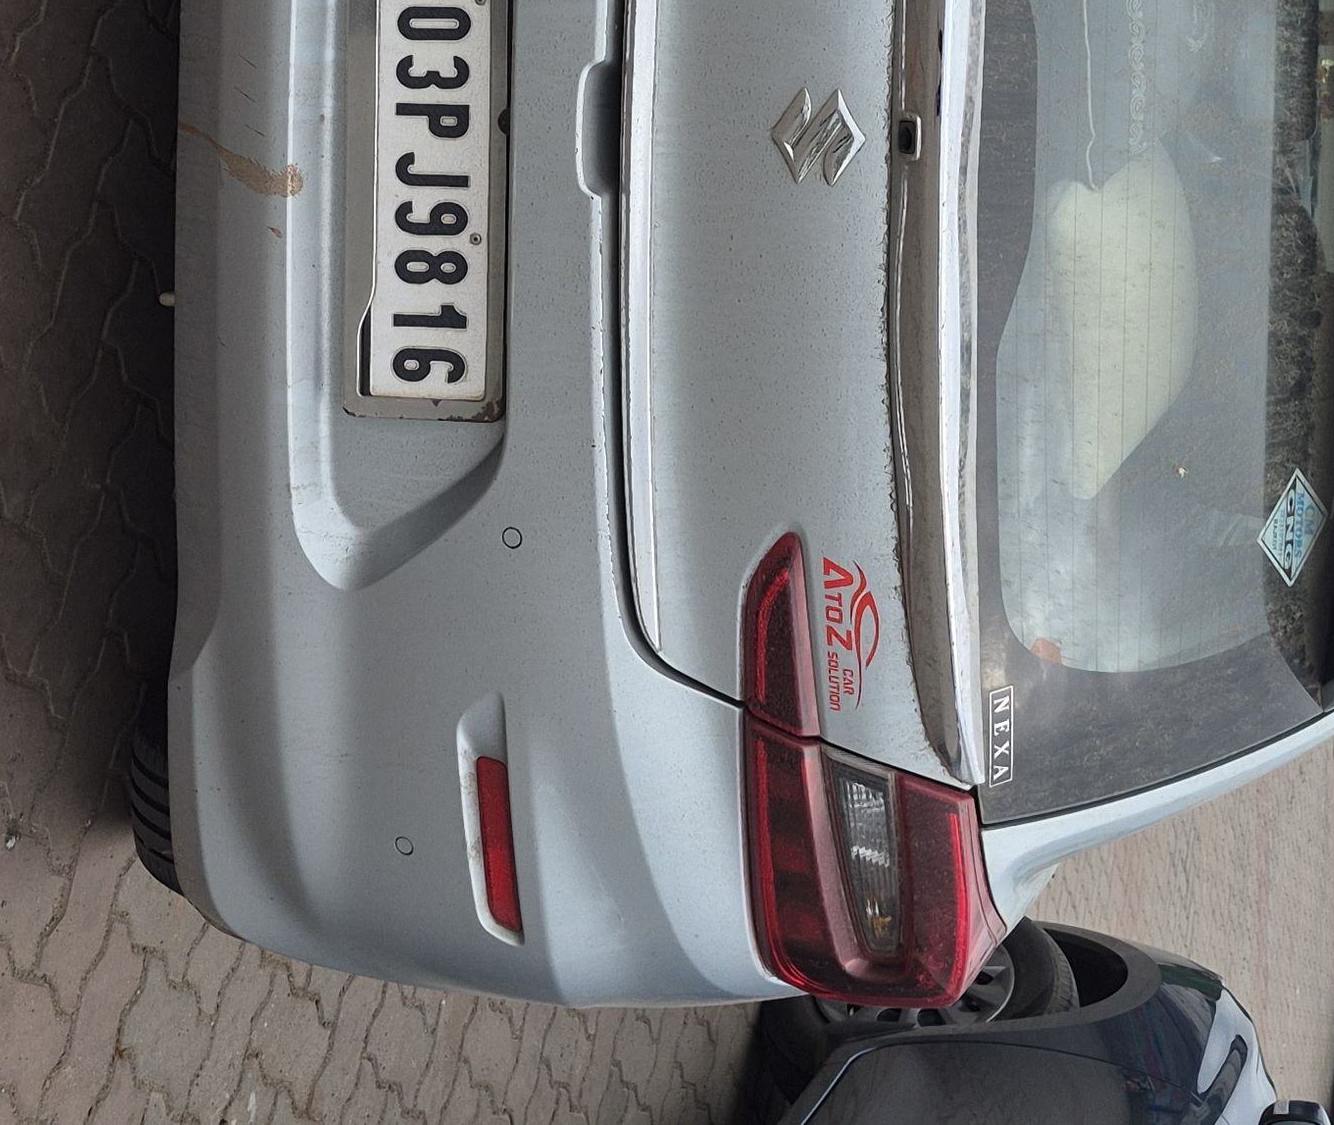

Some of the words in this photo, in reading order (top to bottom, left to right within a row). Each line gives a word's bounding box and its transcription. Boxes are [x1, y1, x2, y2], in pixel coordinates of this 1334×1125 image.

[1284, 489, 1295, 569] CNG
[1294, 492, 1305, 558] MOTORS
[1305, 504, 1315, 536] CM
[827, 651, 841, 711] SOLUTION
[842, 668, 854, 695] CAR
[992, 695, 1010, 781] NEXA
